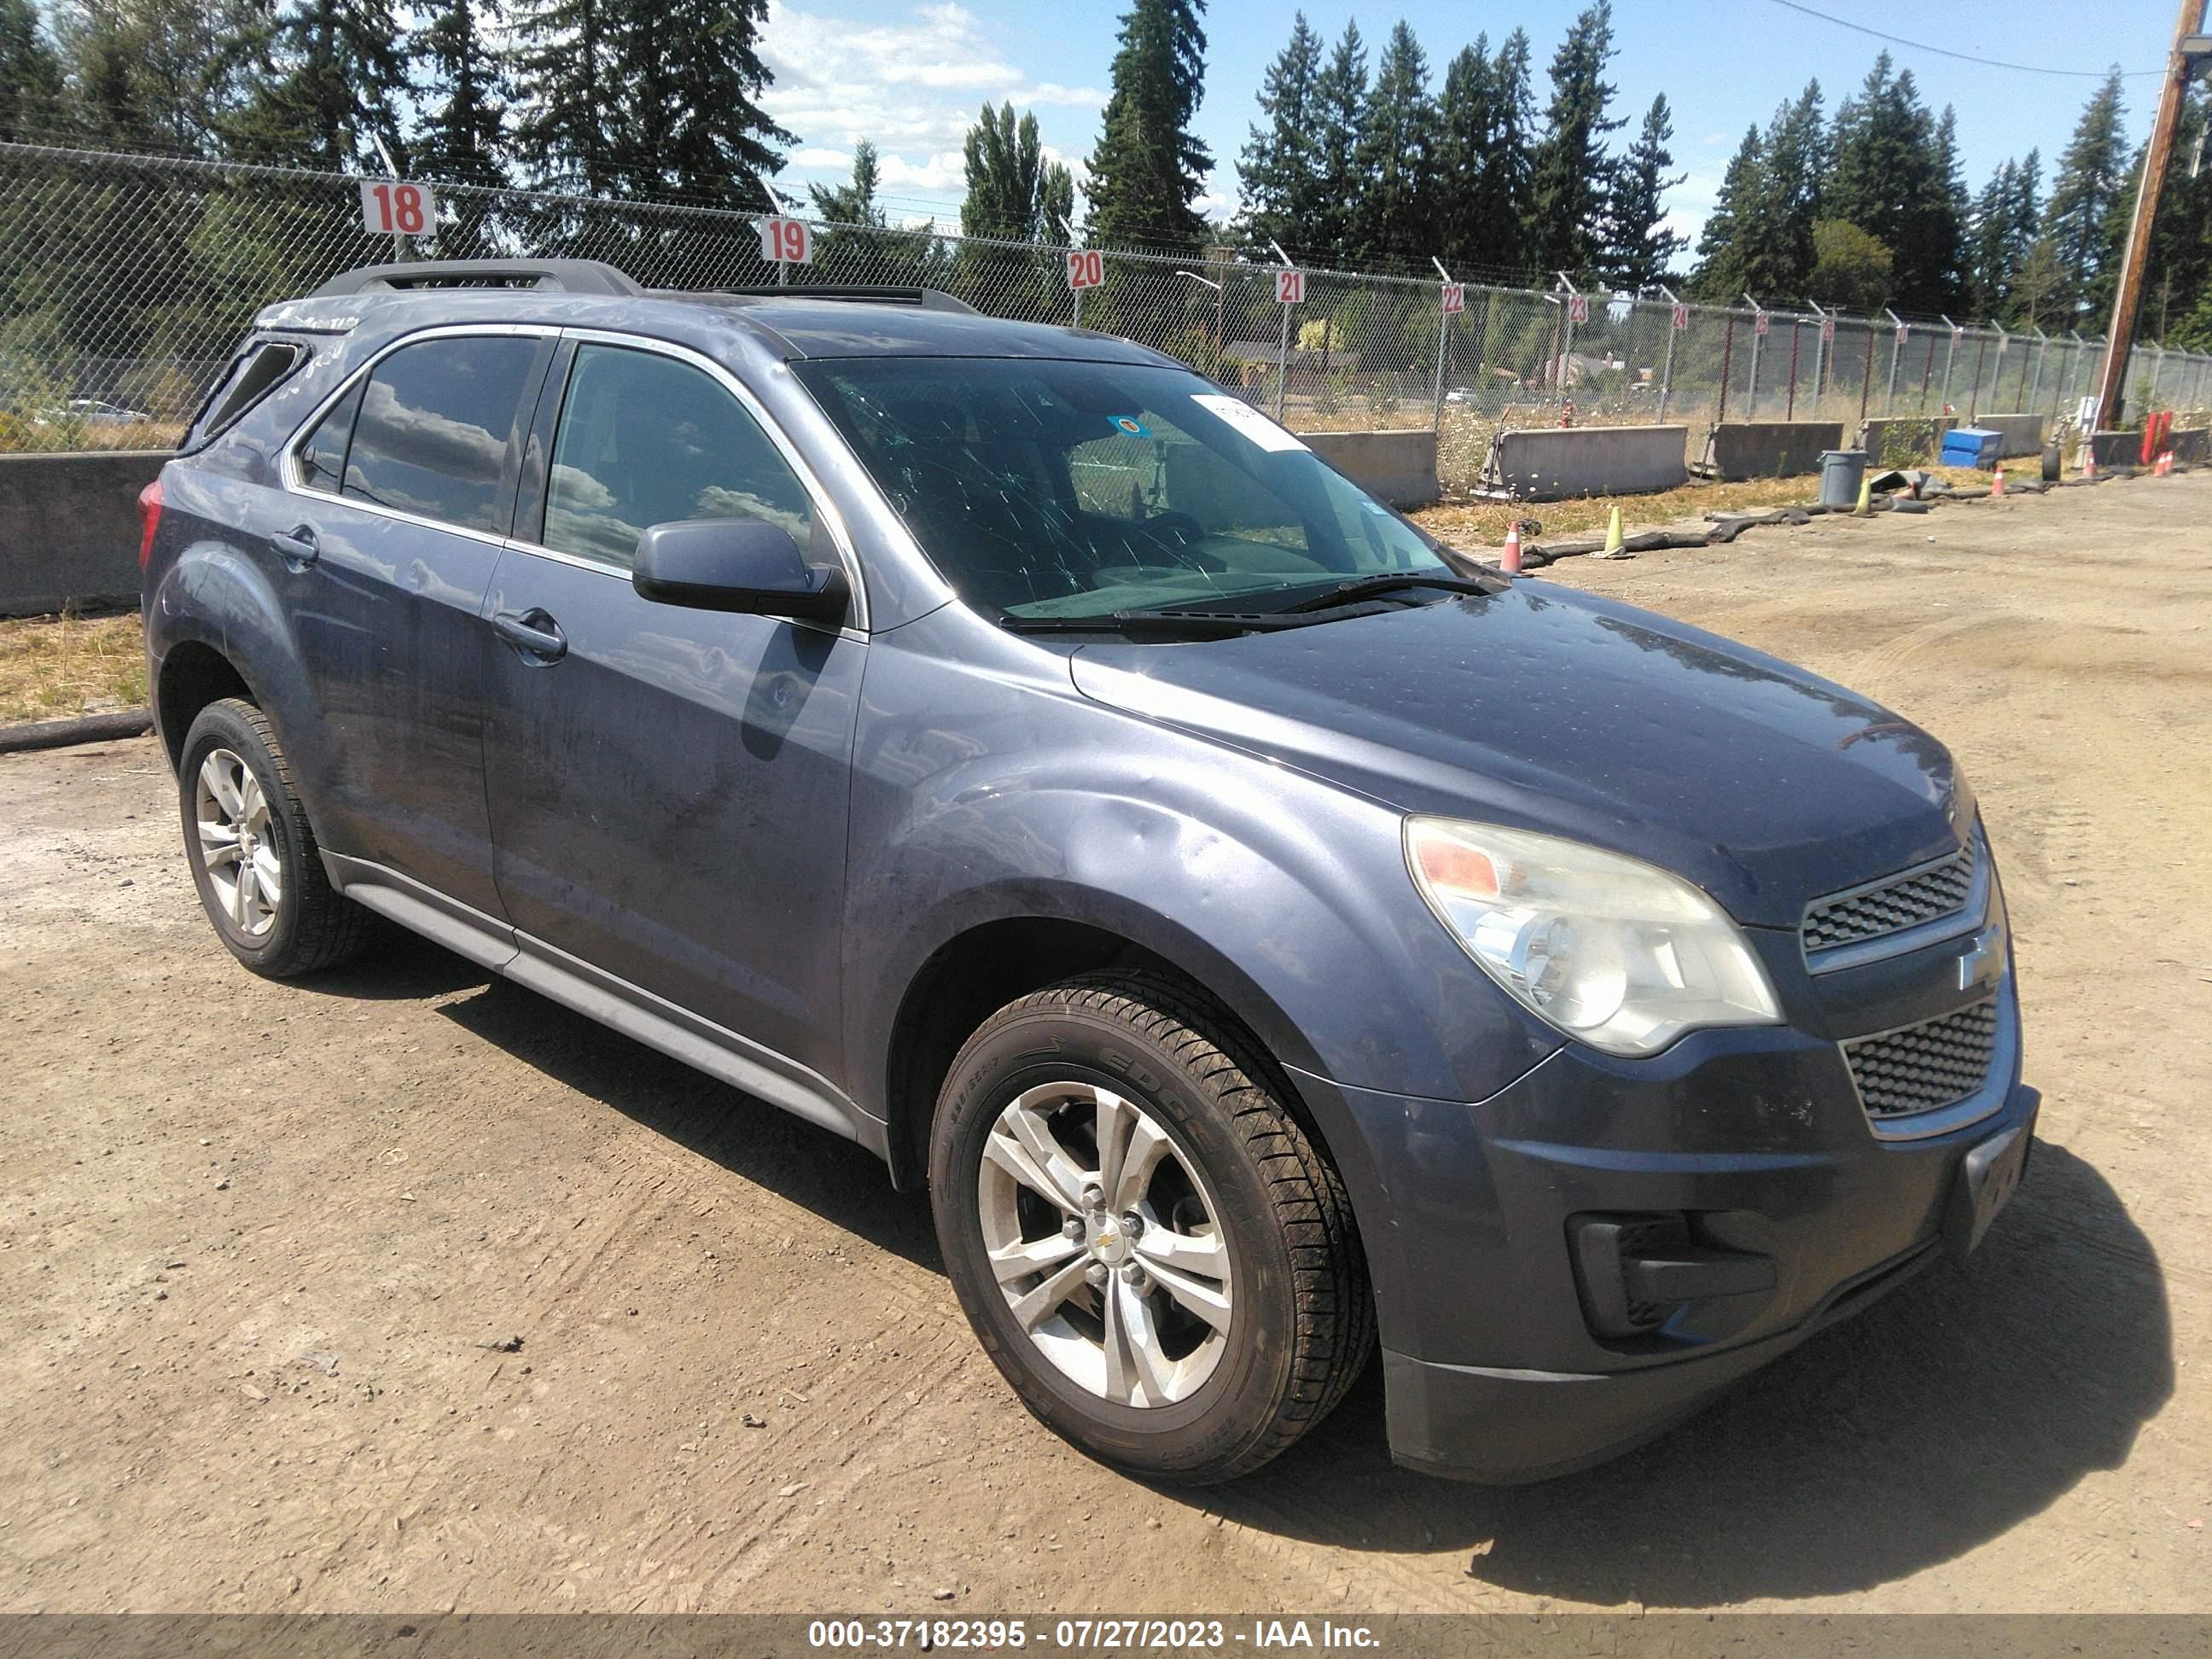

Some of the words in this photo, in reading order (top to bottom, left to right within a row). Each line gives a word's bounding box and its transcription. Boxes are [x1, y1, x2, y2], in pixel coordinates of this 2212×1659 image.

[373, 185, 423, 233] 18
[769, 221, 805, 259] 19
[1070, 253, 1101, 288] 20
[1280, 272, 1301, 301] 21
[1443, 287, 1463, 312] 22
[1569, 298, 1587, 322] 23
[1673, 306, 1687, 329] 24
[1098, 1046, 1221, 1157] EDGE
